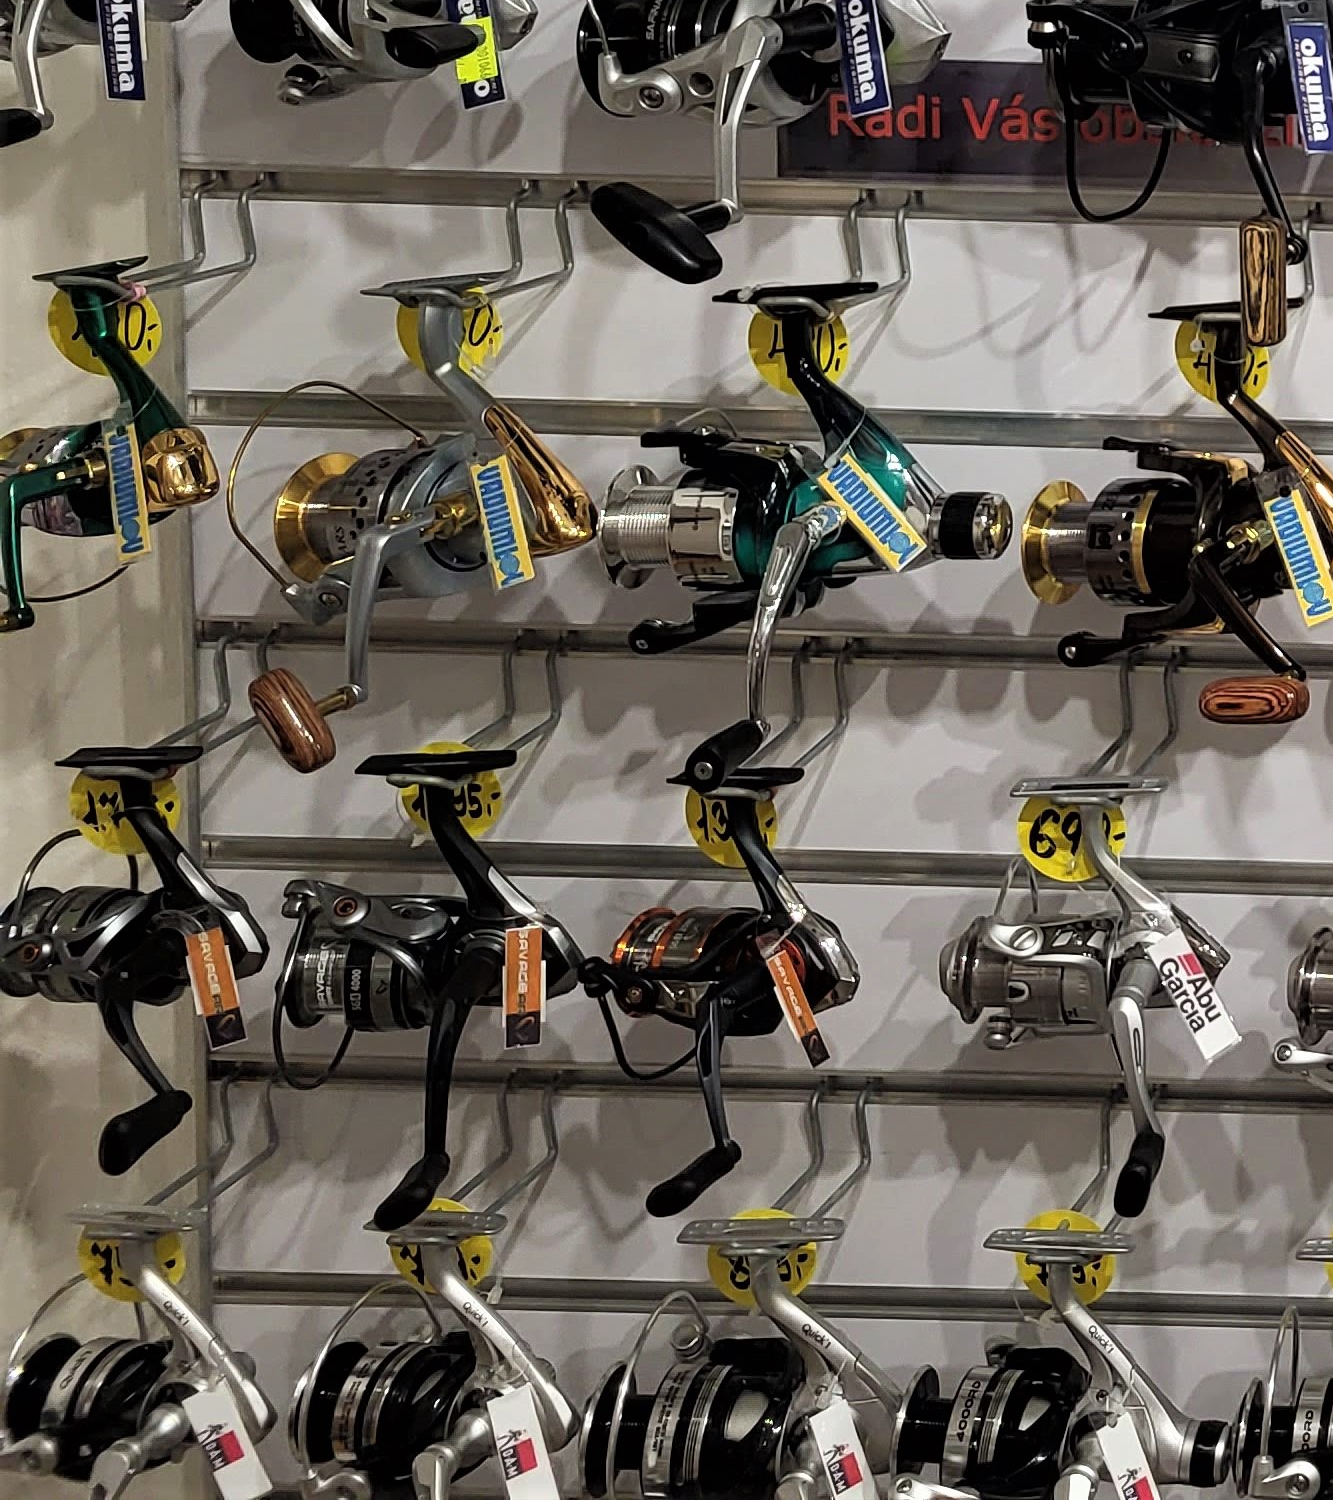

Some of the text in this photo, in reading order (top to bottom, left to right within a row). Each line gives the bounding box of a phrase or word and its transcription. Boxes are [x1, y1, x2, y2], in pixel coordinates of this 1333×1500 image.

[961, 93, 1062, 144] Vás
[1300, 37, 1330, 142] okuma
[1159, 957, 1206, 1033] Garcia
[1186, 977, 1222, 1023] Abu
